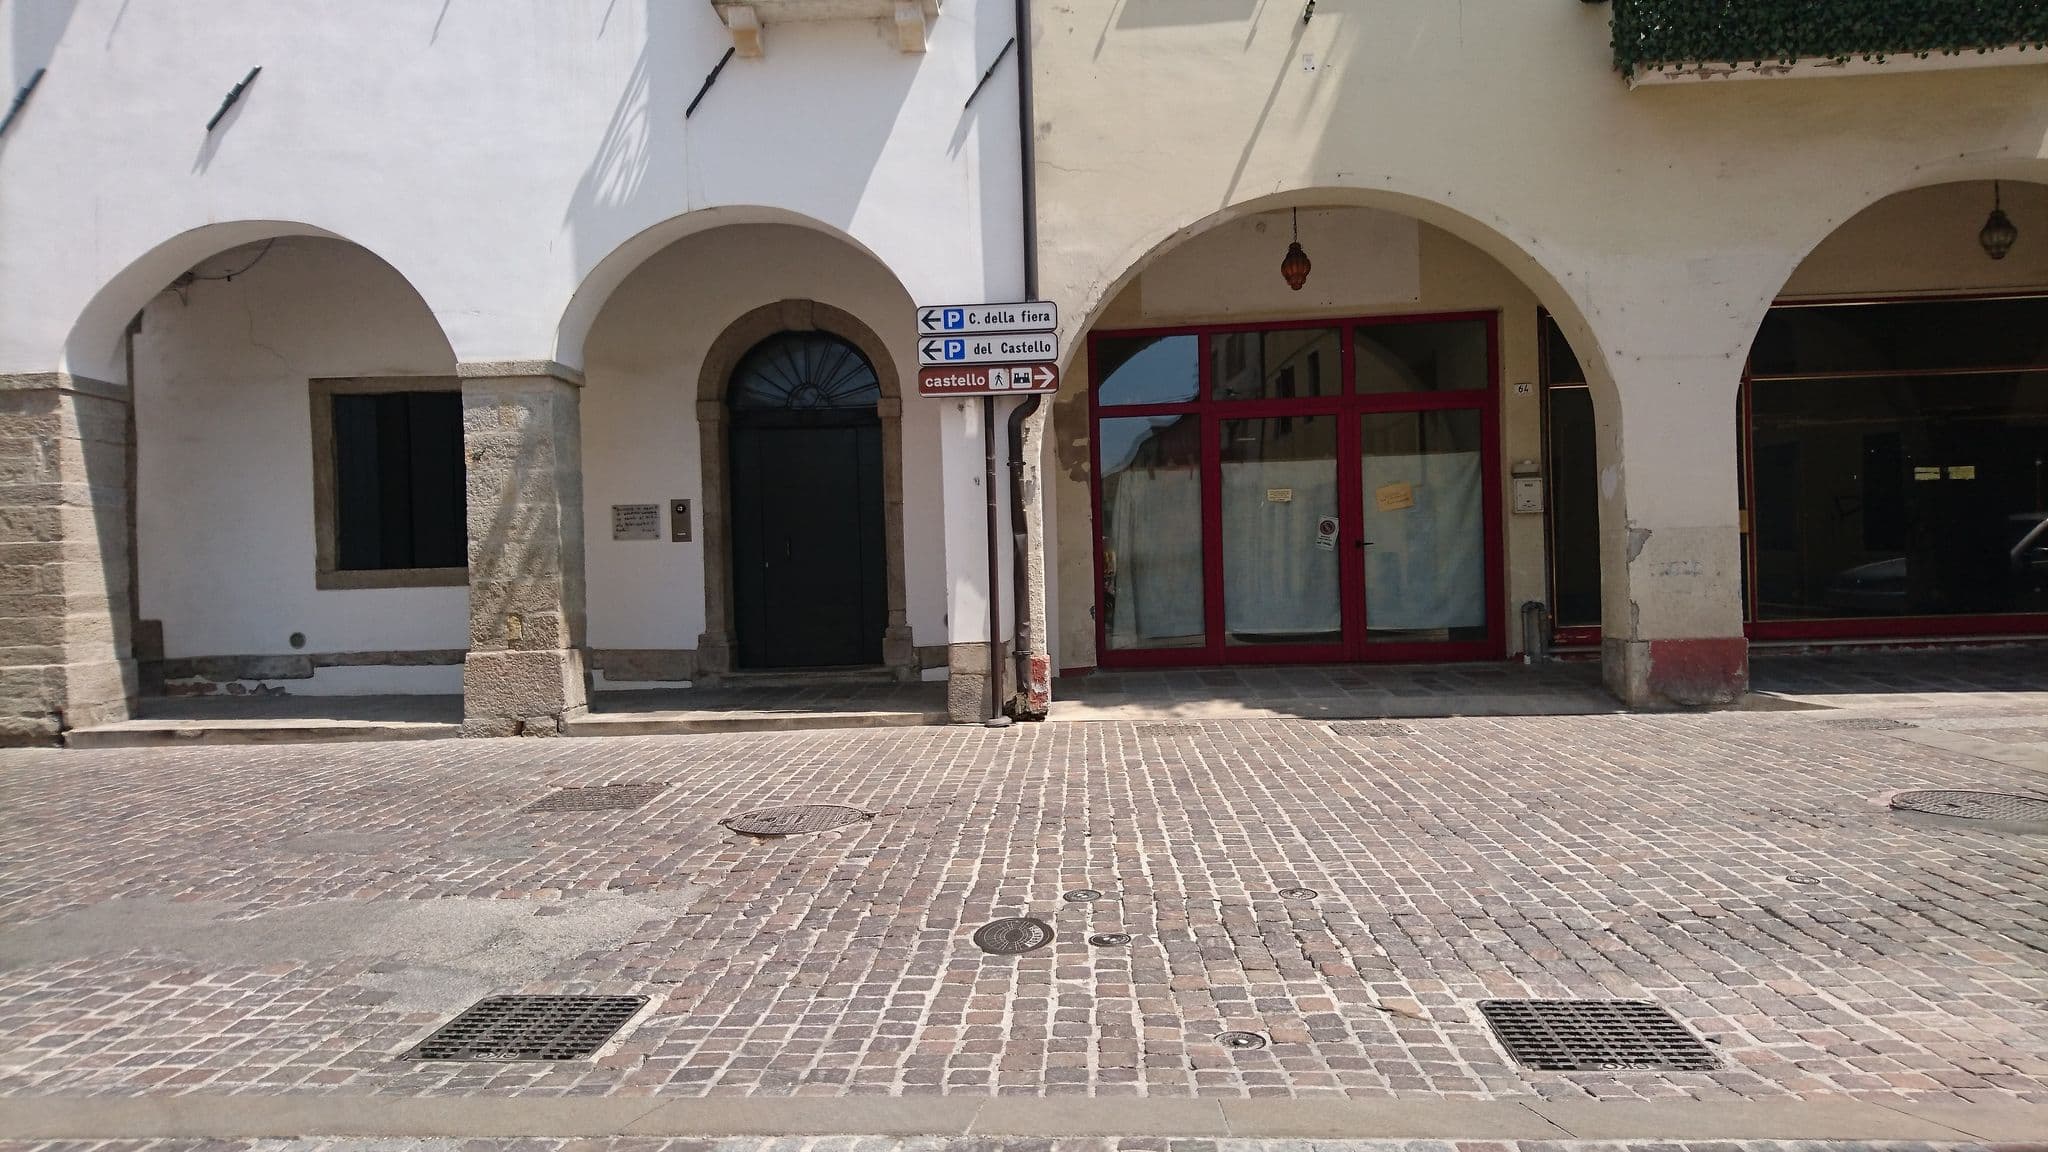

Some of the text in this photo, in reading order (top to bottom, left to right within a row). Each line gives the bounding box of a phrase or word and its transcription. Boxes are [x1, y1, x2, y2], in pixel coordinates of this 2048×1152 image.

[969, 313, 981, 325] C.
[984, 311, 1015, 324] della
[1021, 310, 1050, 323] fiera
[973, 342, 993, 355] del
[1000, 340, 1051, 354] Castello
[925, 373, 986, 388] castello
[1518, 383, 1529, 393] 64
